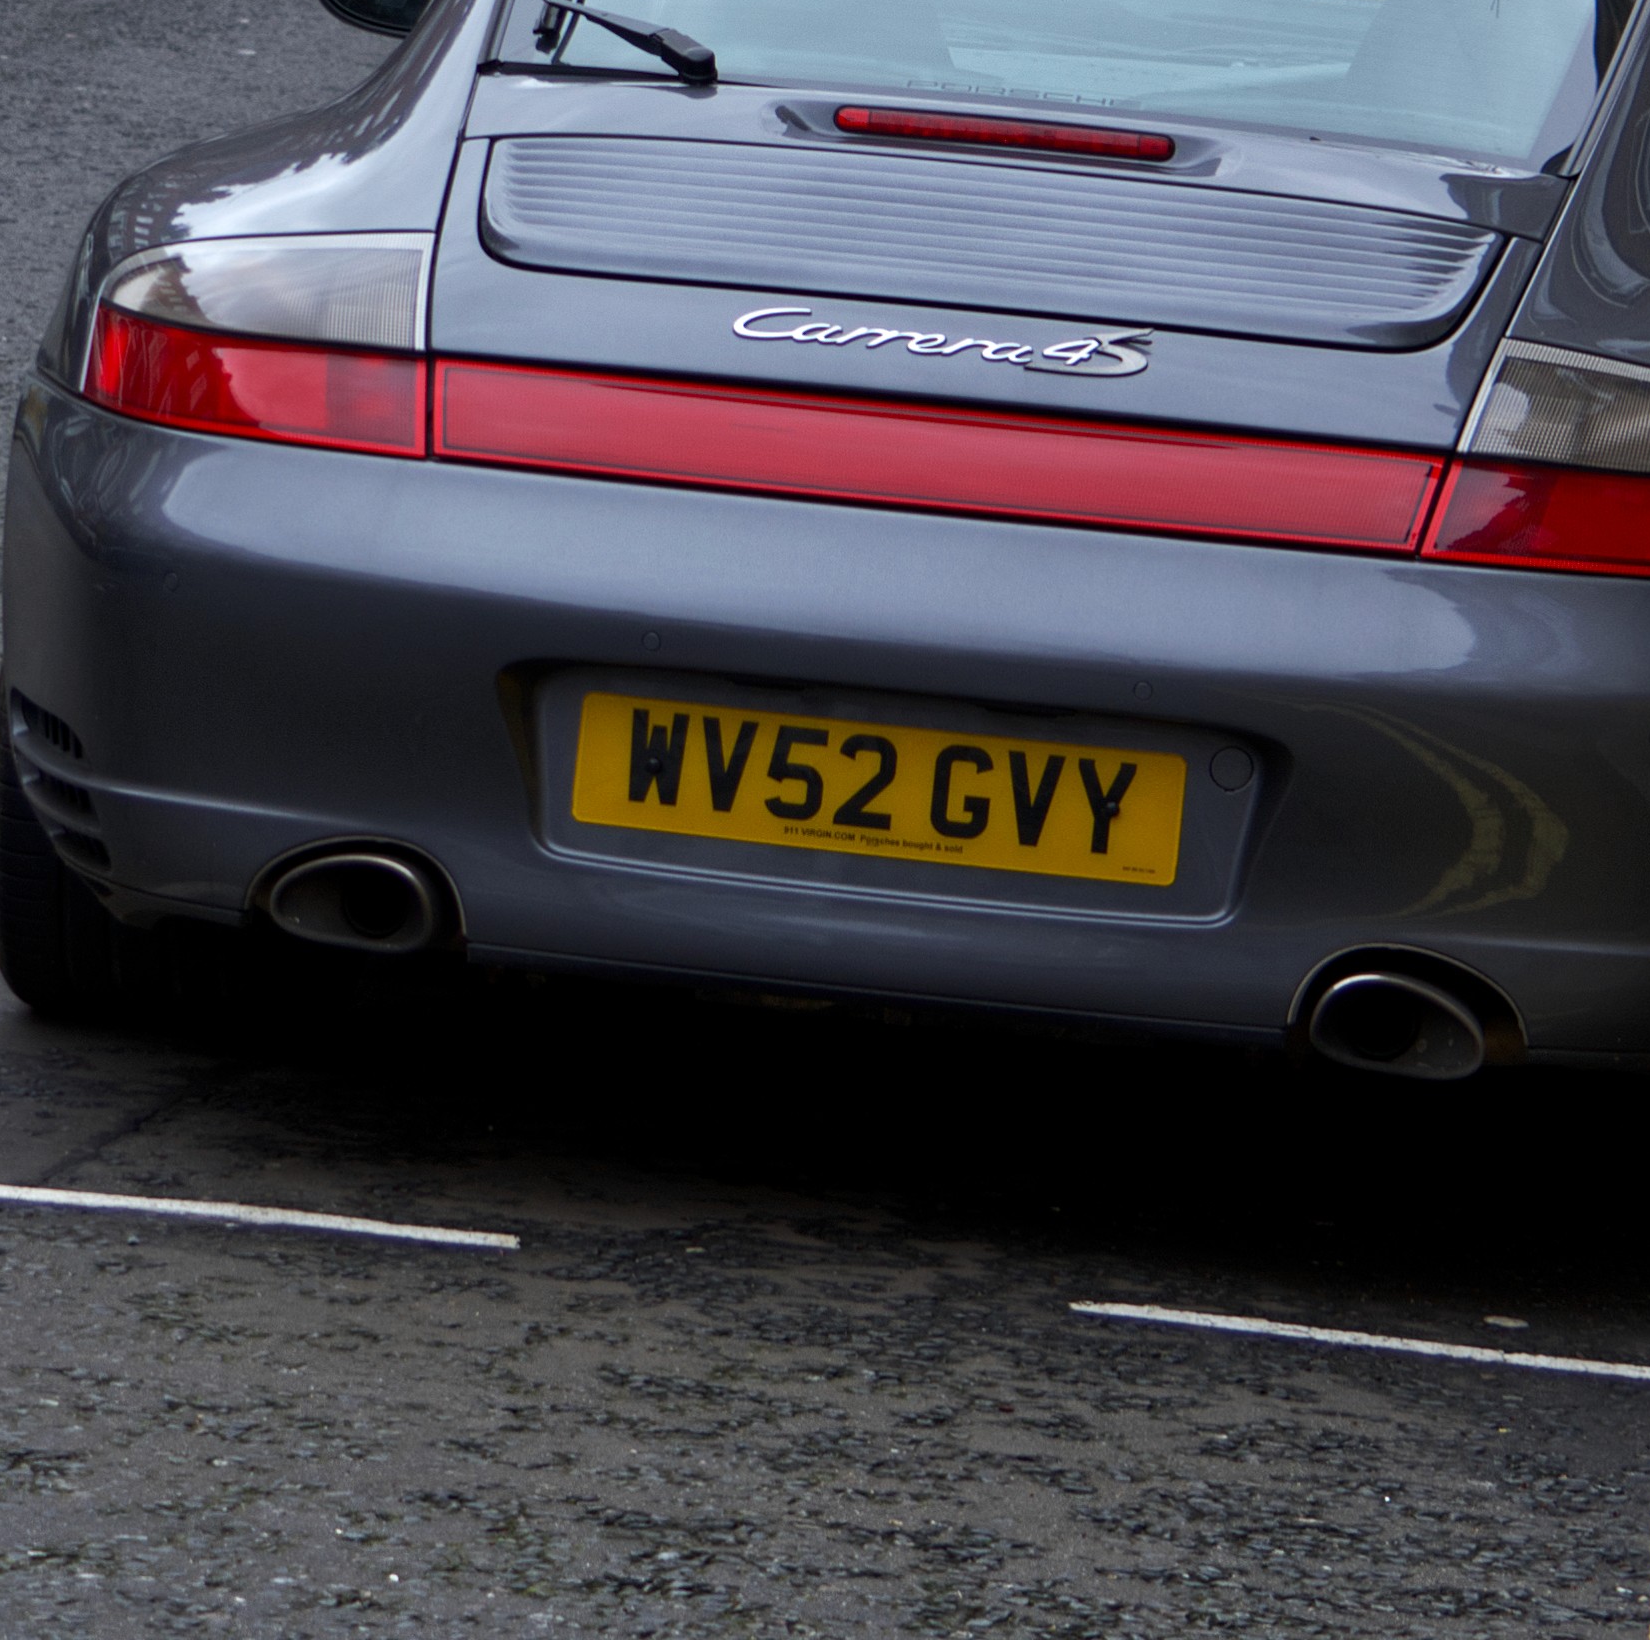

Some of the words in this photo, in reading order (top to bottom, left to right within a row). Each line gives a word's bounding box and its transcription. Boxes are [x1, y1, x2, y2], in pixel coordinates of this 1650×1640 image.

[732, 306, 1033, 364] Carrera
[628, 707, 899, 831] WV52
[930, 744, 1138, 855] GVY
